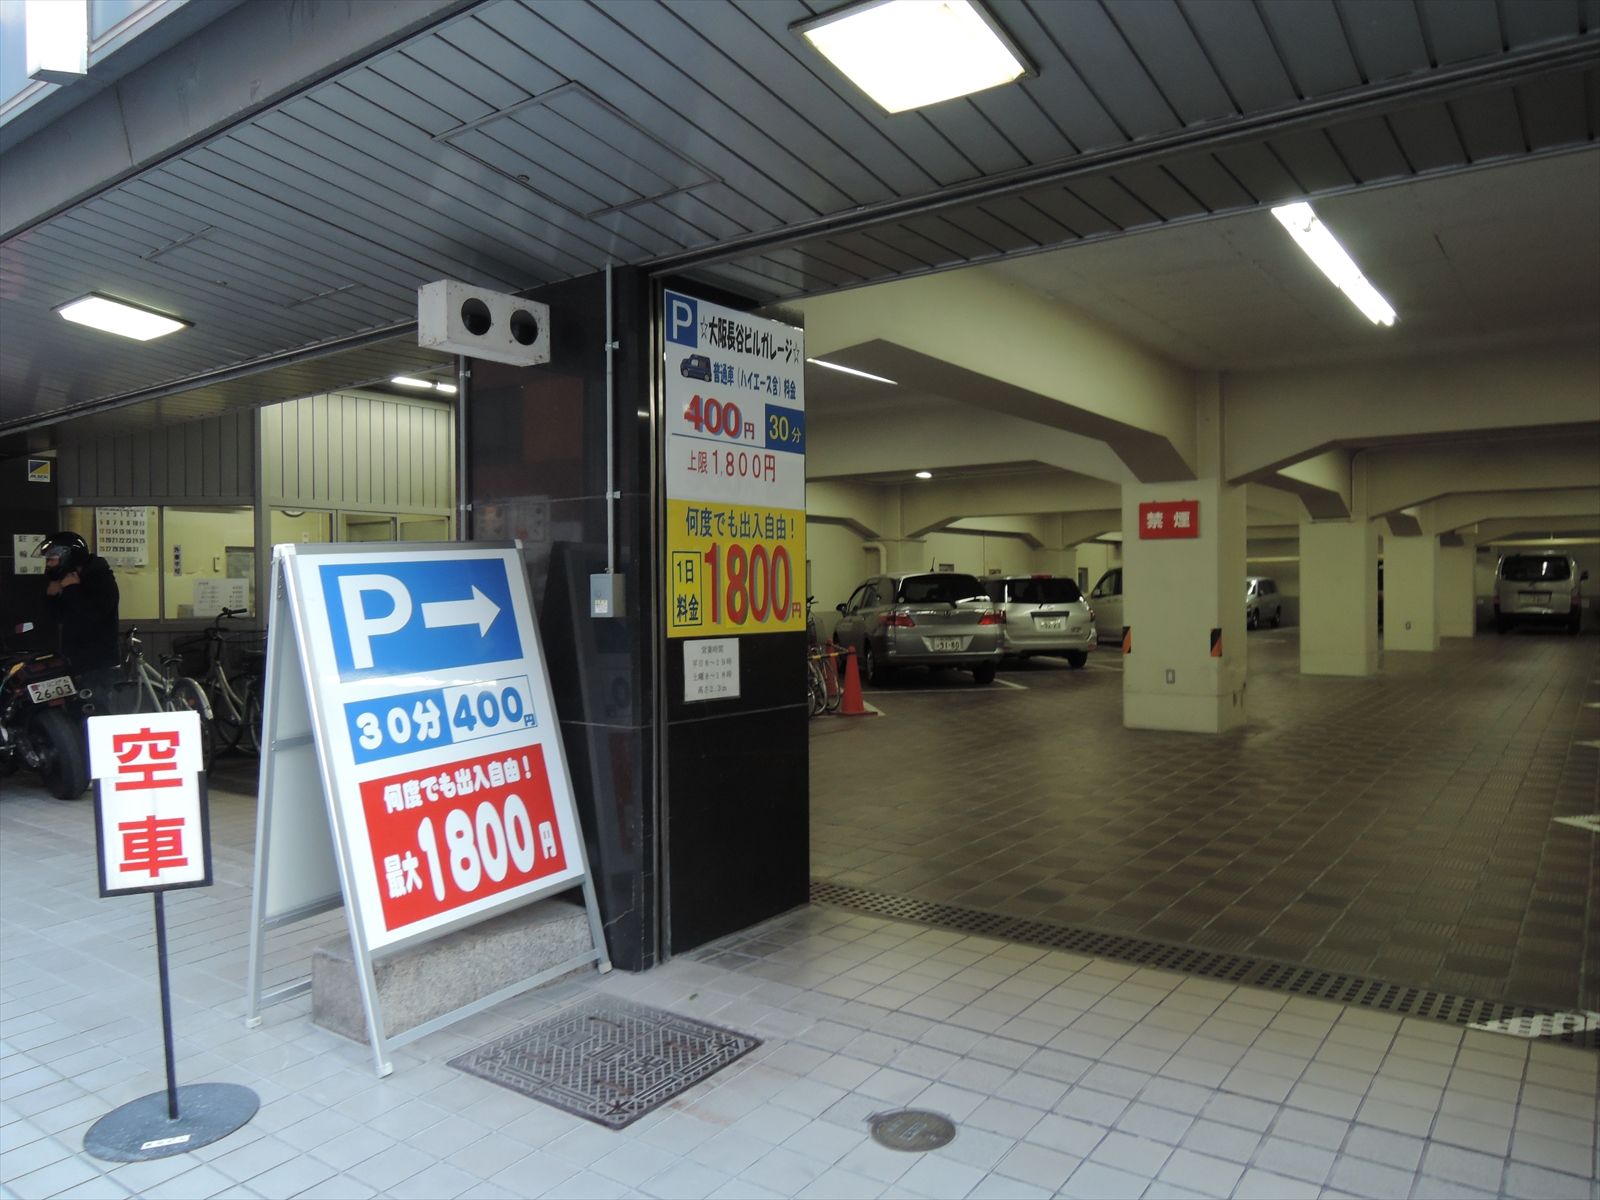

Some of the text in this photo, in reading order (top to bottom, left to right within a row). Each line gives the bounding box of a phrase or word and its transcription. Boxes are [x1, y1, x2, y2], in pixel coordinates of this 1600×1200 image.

[672, 300, 693, 339] P
[769, 414, 801, 443] 30分
[686, 506, 794, 540] 何度でも出入自由！
[338, 574, 413, 670] P
[676, 594, 699, 622] 料金
[356, 698, 441, 750] 30分
[113, 727, 189, 878] 空車
[384, 755, 532, 814] 何度でも出入自由！
